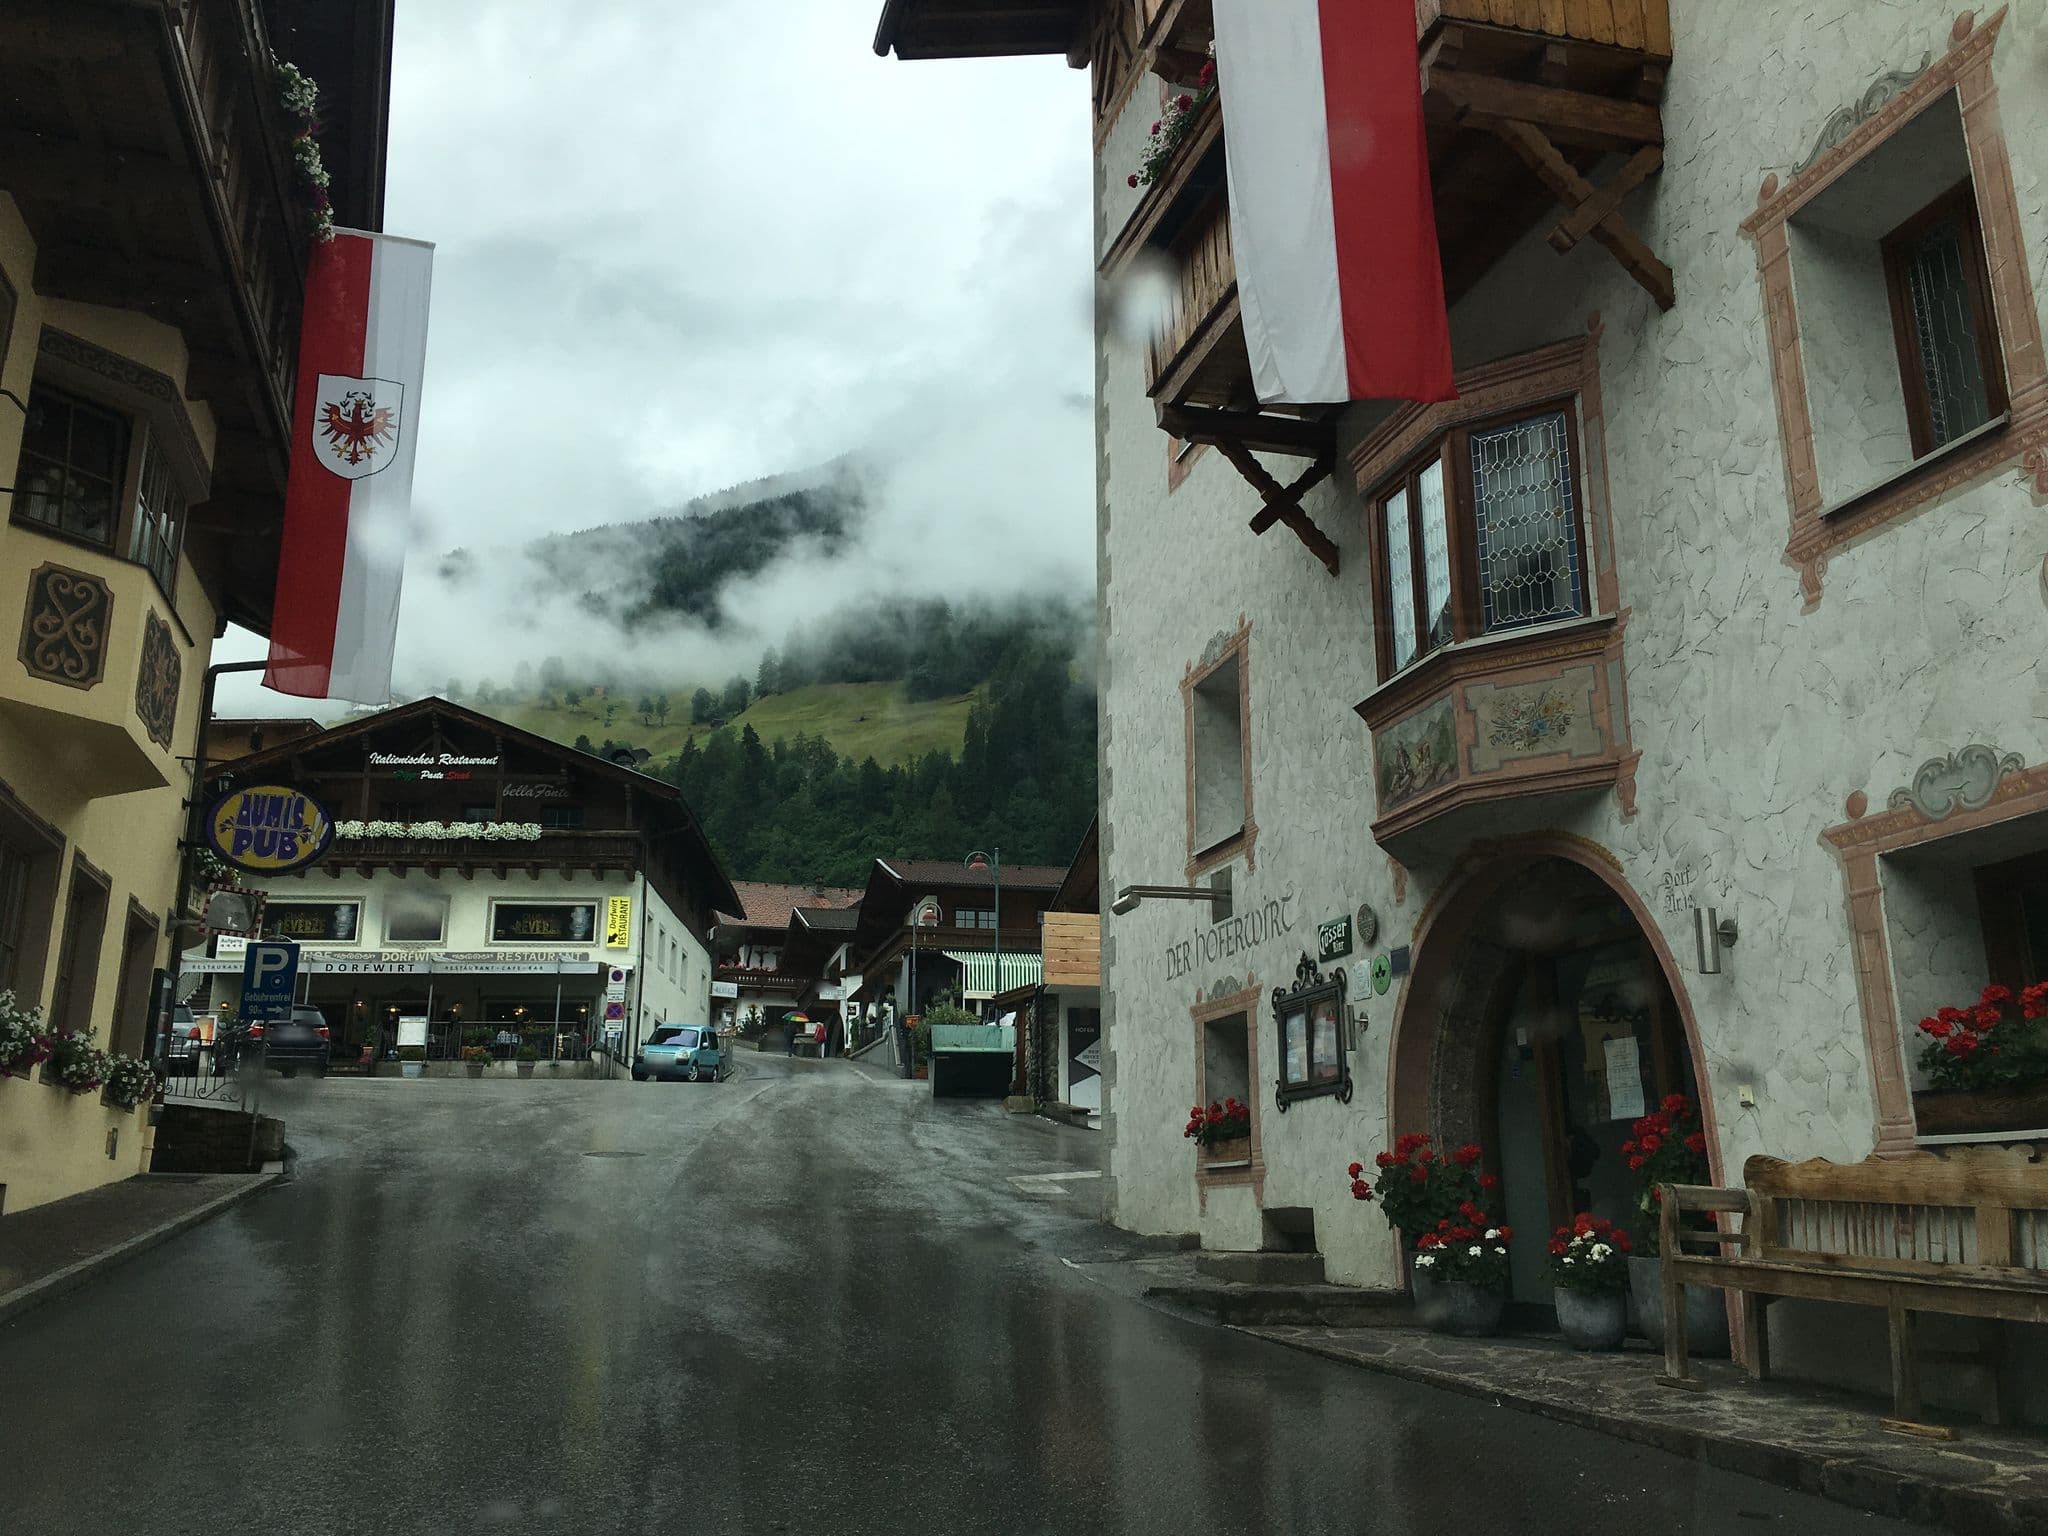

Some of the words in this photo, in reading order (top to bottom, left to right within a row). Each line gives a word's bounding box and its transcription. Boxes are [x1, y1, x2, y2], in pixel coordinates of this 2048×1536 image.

[369, 752, 435, 765] Italienisches
[438, 753, 499, 765] Restaurant
[232, 827, 300, 860] PUB
[609, 899, 618, 929] Dorfwirt
[618, 899, 629, 945] RESTAURANT
[1318, 922, 1347, 955] Gösser
[252, 947, 289, 988] P
[325, 963, 415, 972] DORFWIRT
[1166, 940, 1191, 981] DER
